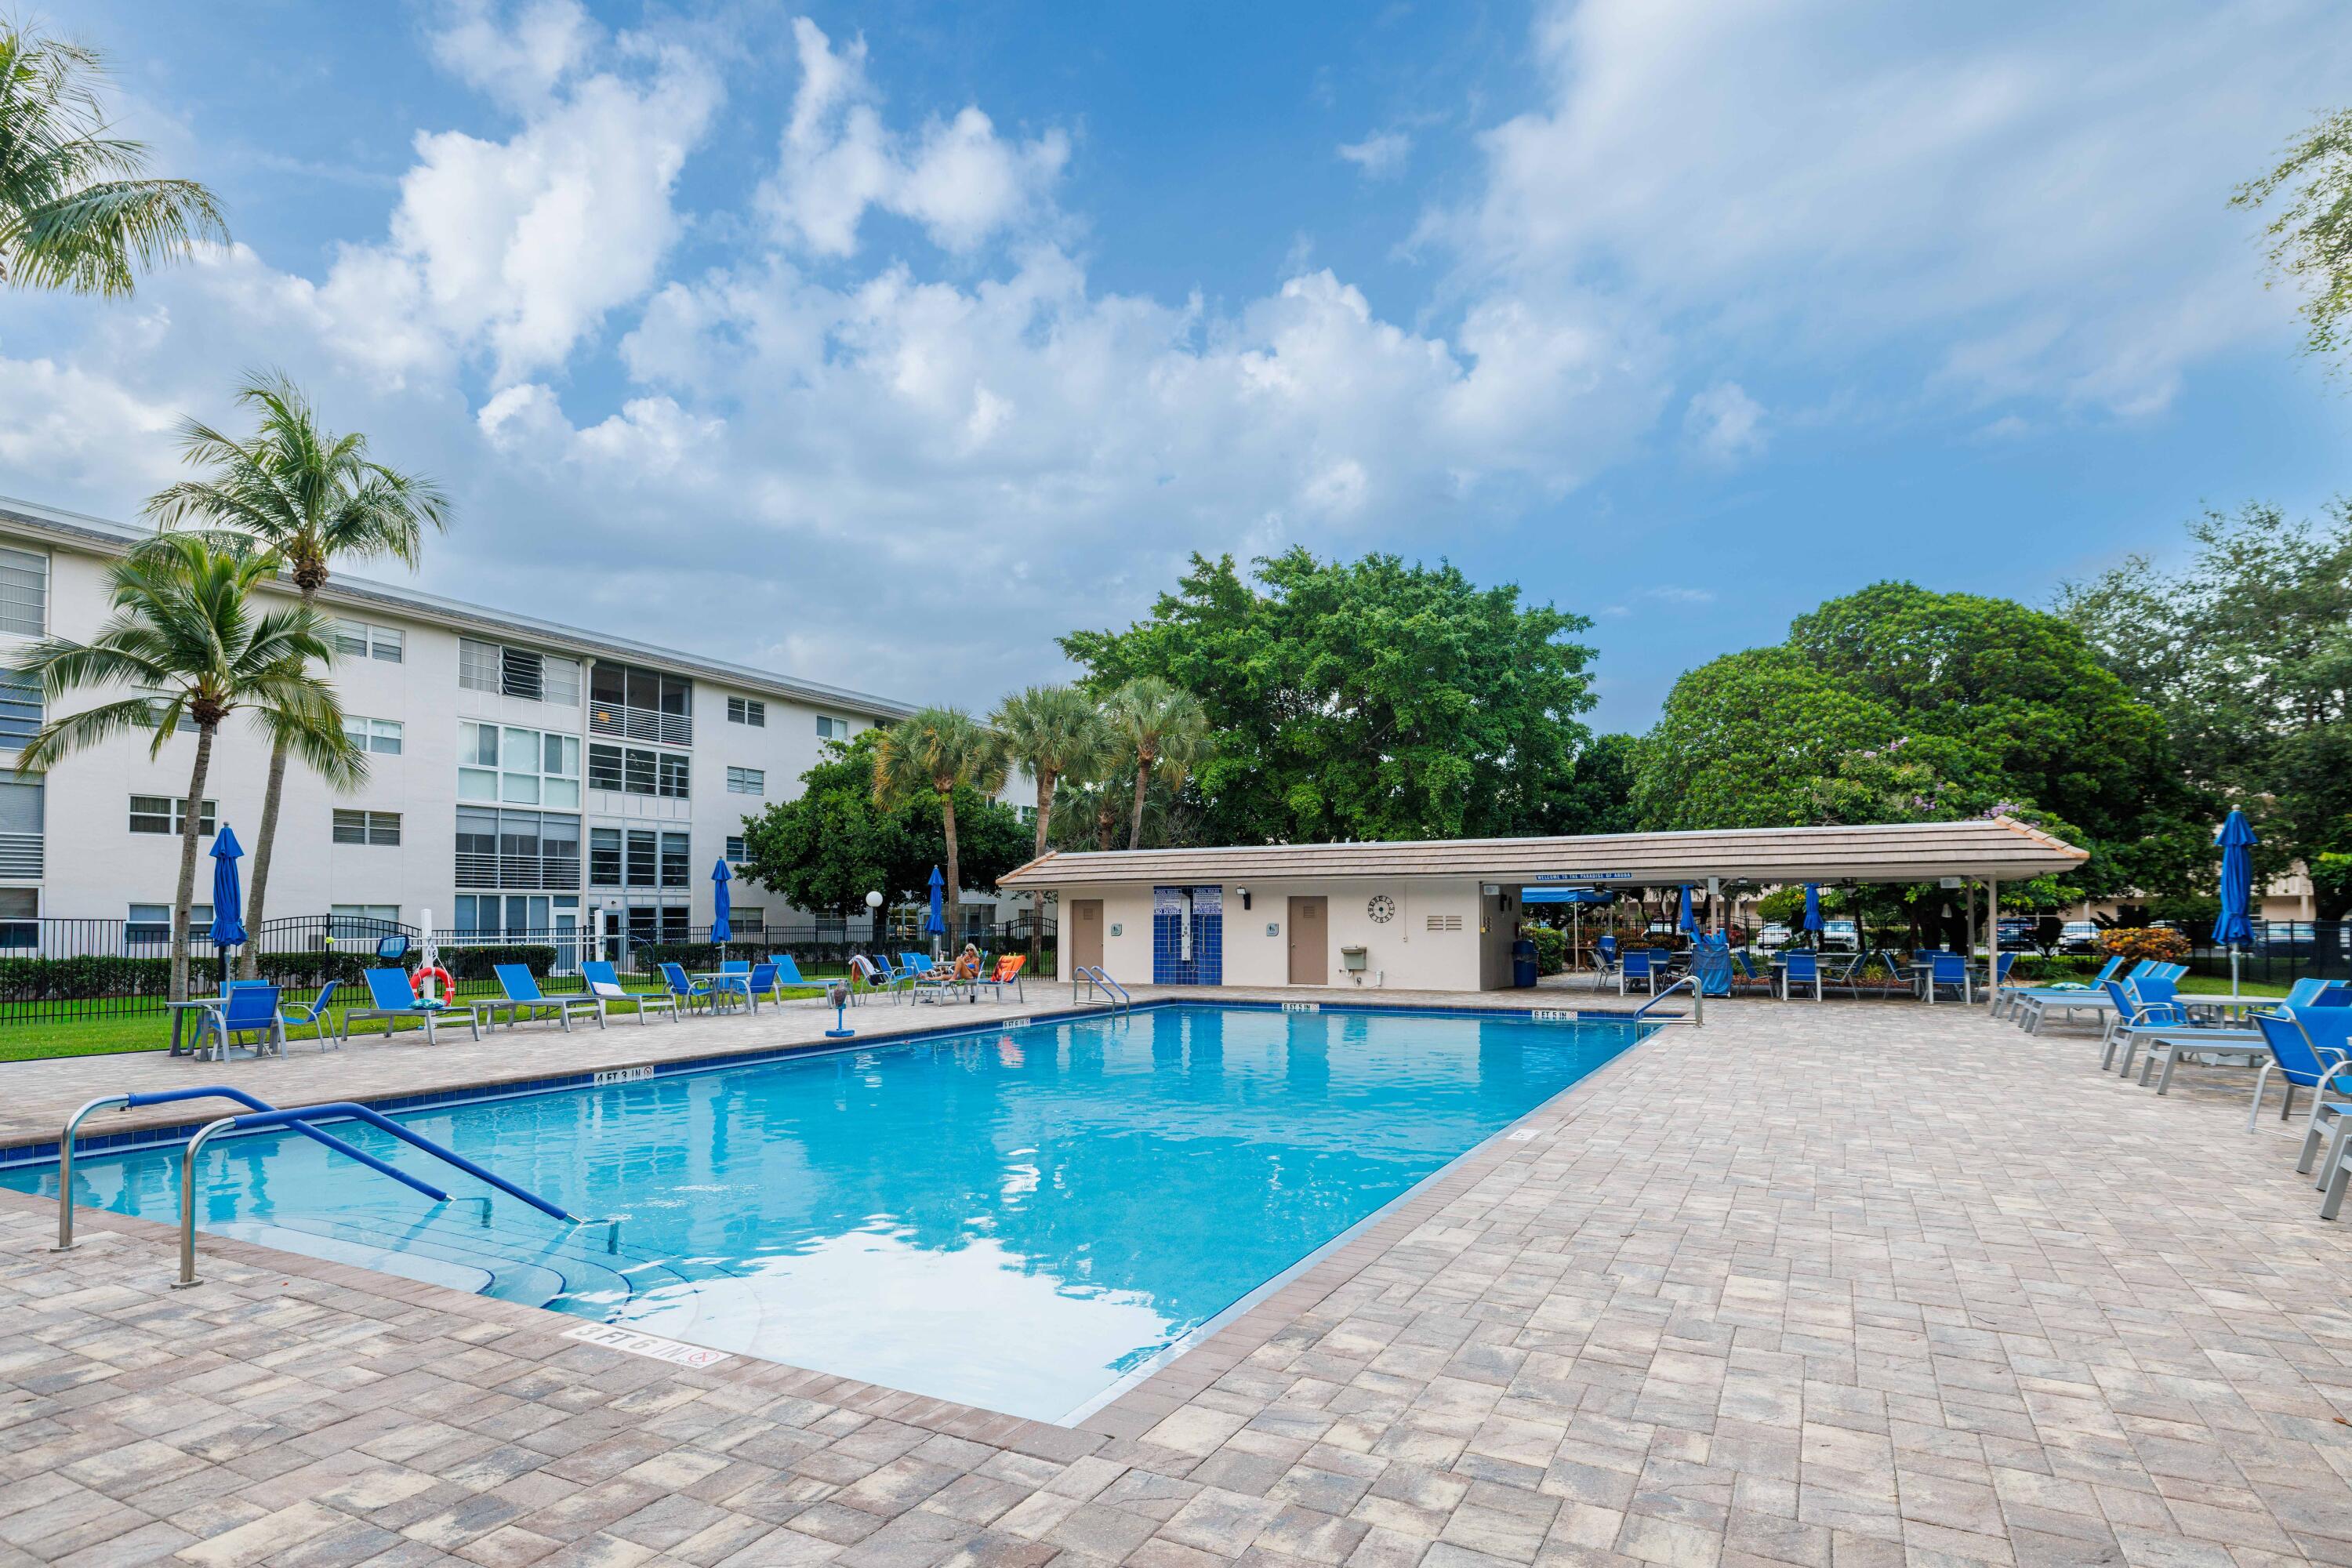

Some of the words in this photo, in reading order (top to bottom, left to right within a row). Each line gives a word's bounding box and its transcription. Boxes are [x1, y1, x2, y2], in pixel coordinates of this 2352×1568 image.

[597, 1073, 603, 1083] 4
[607, 1072, 618, 1081] FT
[621, 1070, 627, 1080] 3
[631, 1069, 641, 1079] IN
[575, 1327, 604, 1336] 3
[593, 1330, 637, 1345] FT
[628, 1339, 658, 1349] 6
[652, 1341, 692, 1359] IN
